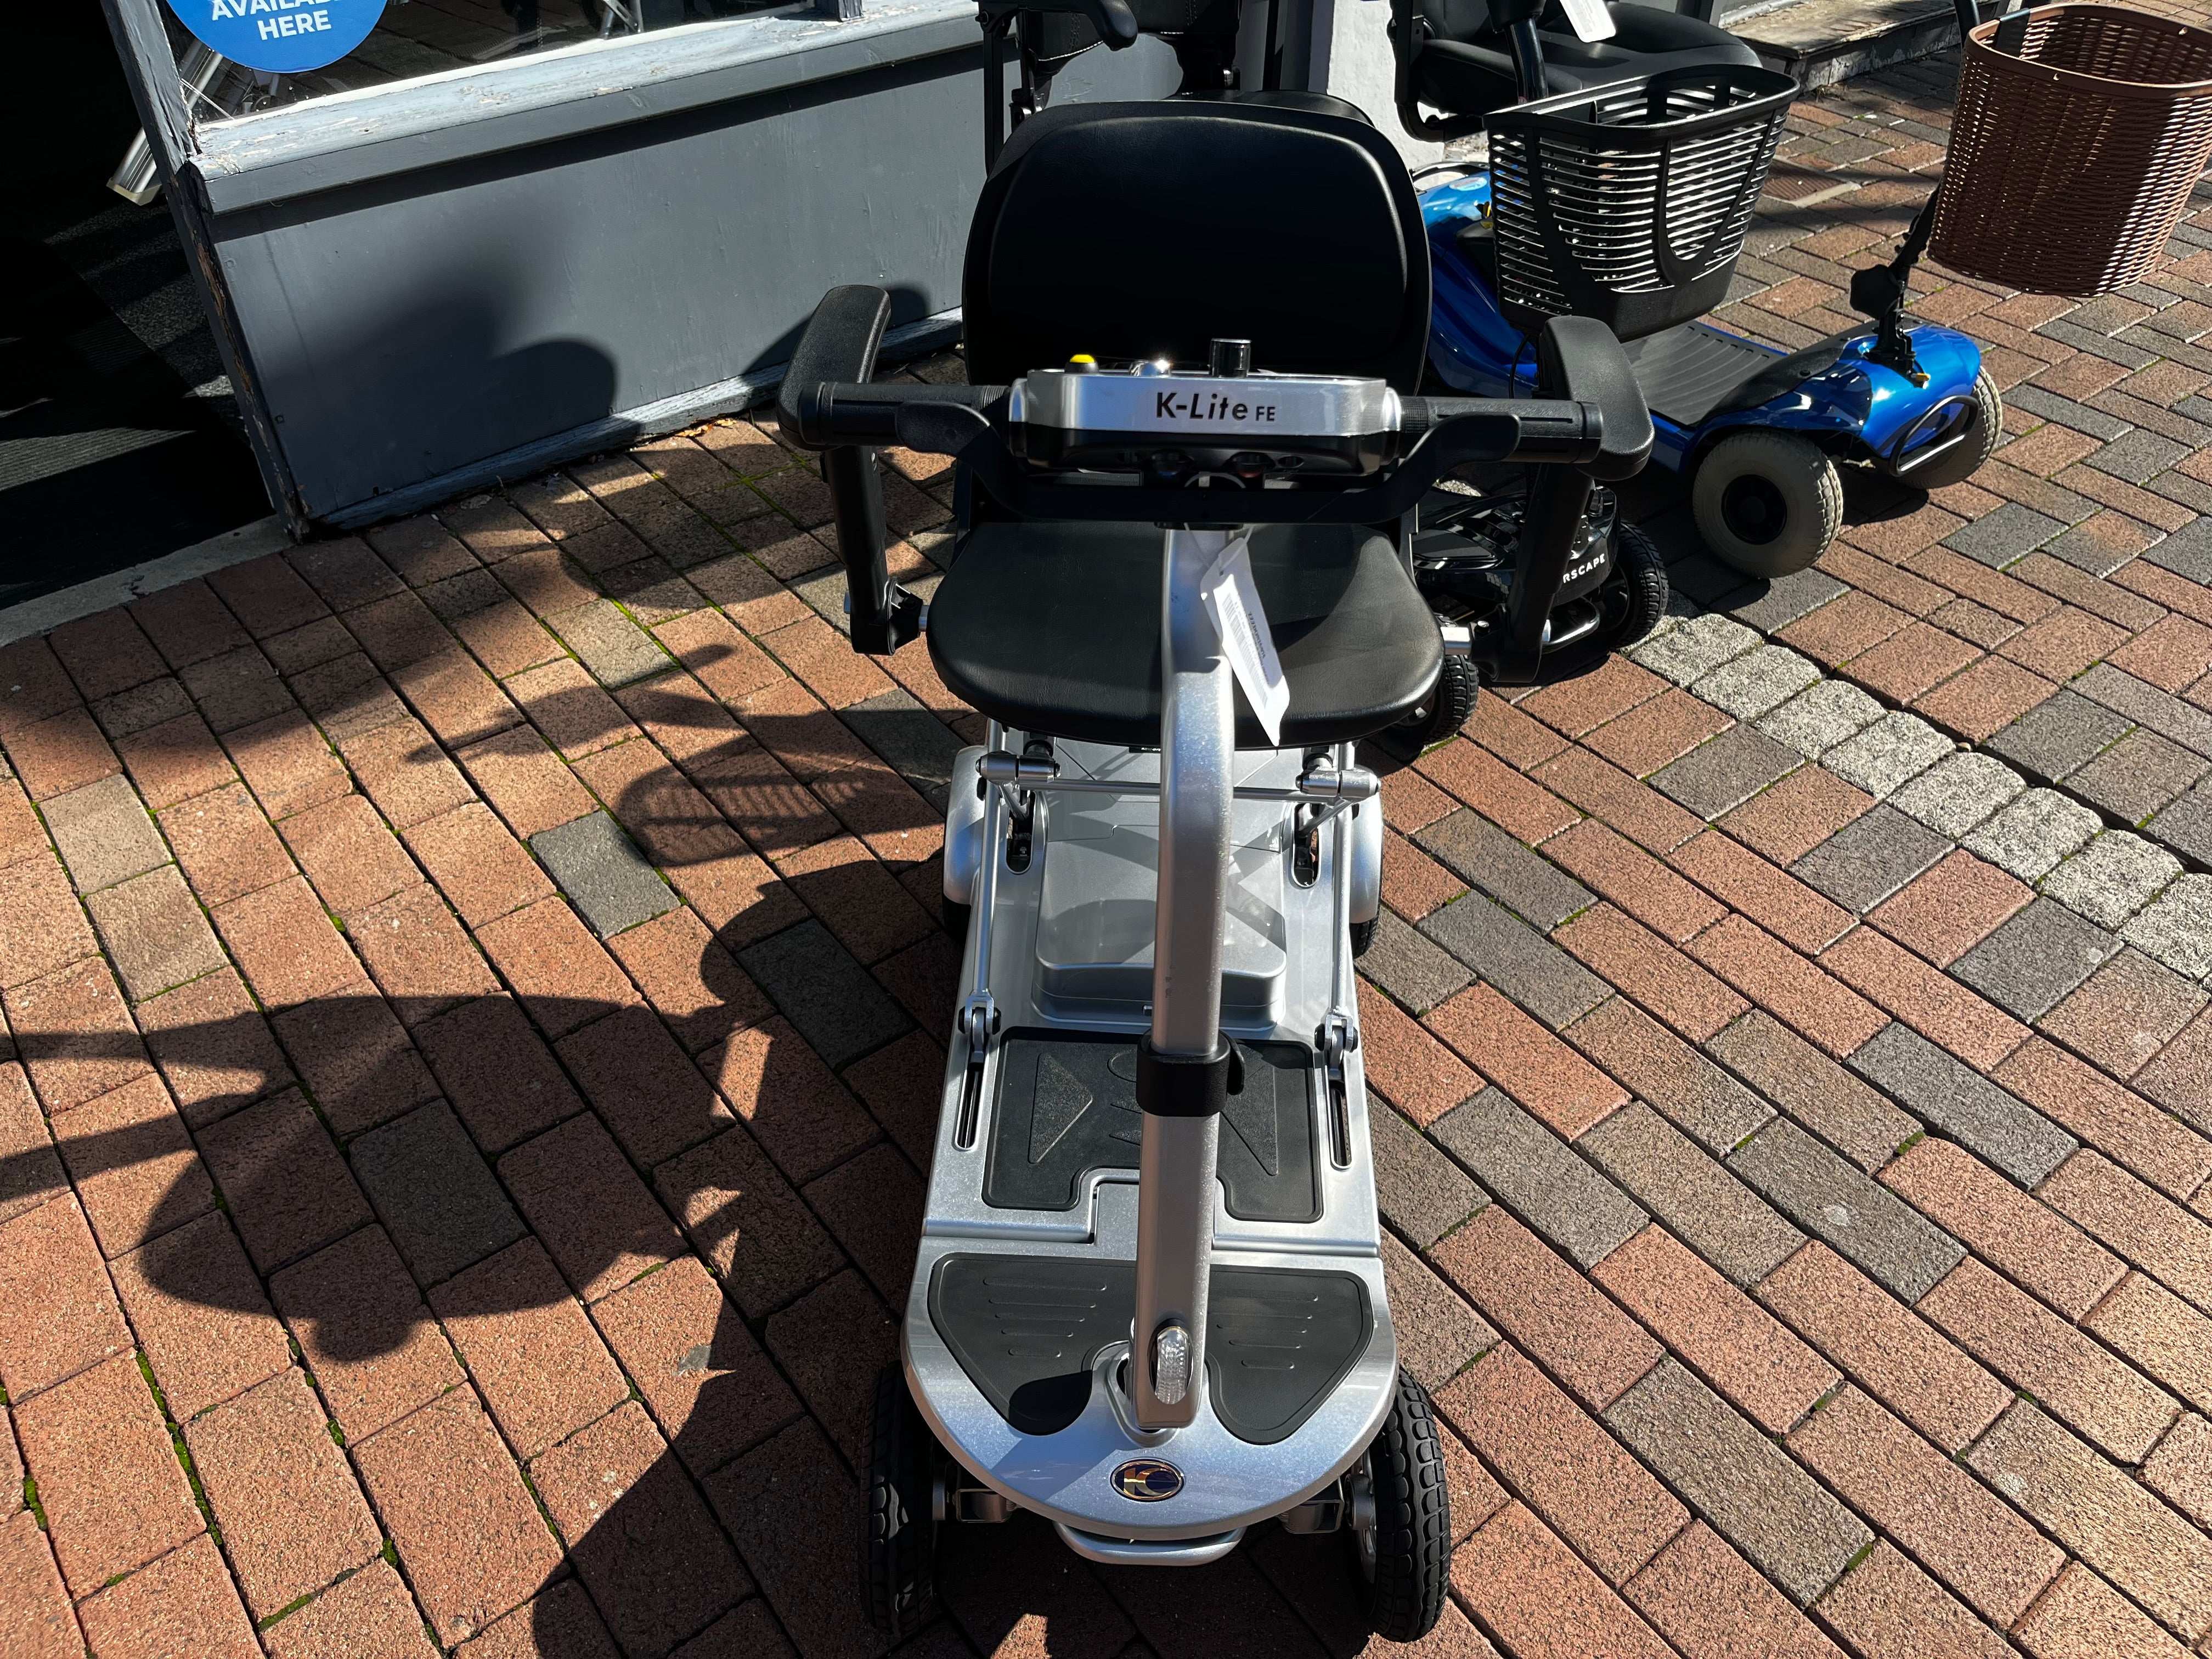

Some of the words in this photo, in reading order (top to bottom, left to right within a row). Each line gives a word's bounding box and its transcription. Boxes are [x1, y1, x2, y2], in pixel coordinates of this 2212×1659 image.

[257, 10, 332, 40] HERE
[1156, 392, 1248, 421] K-Lite
[1256, 406, 1276, 421] FE
